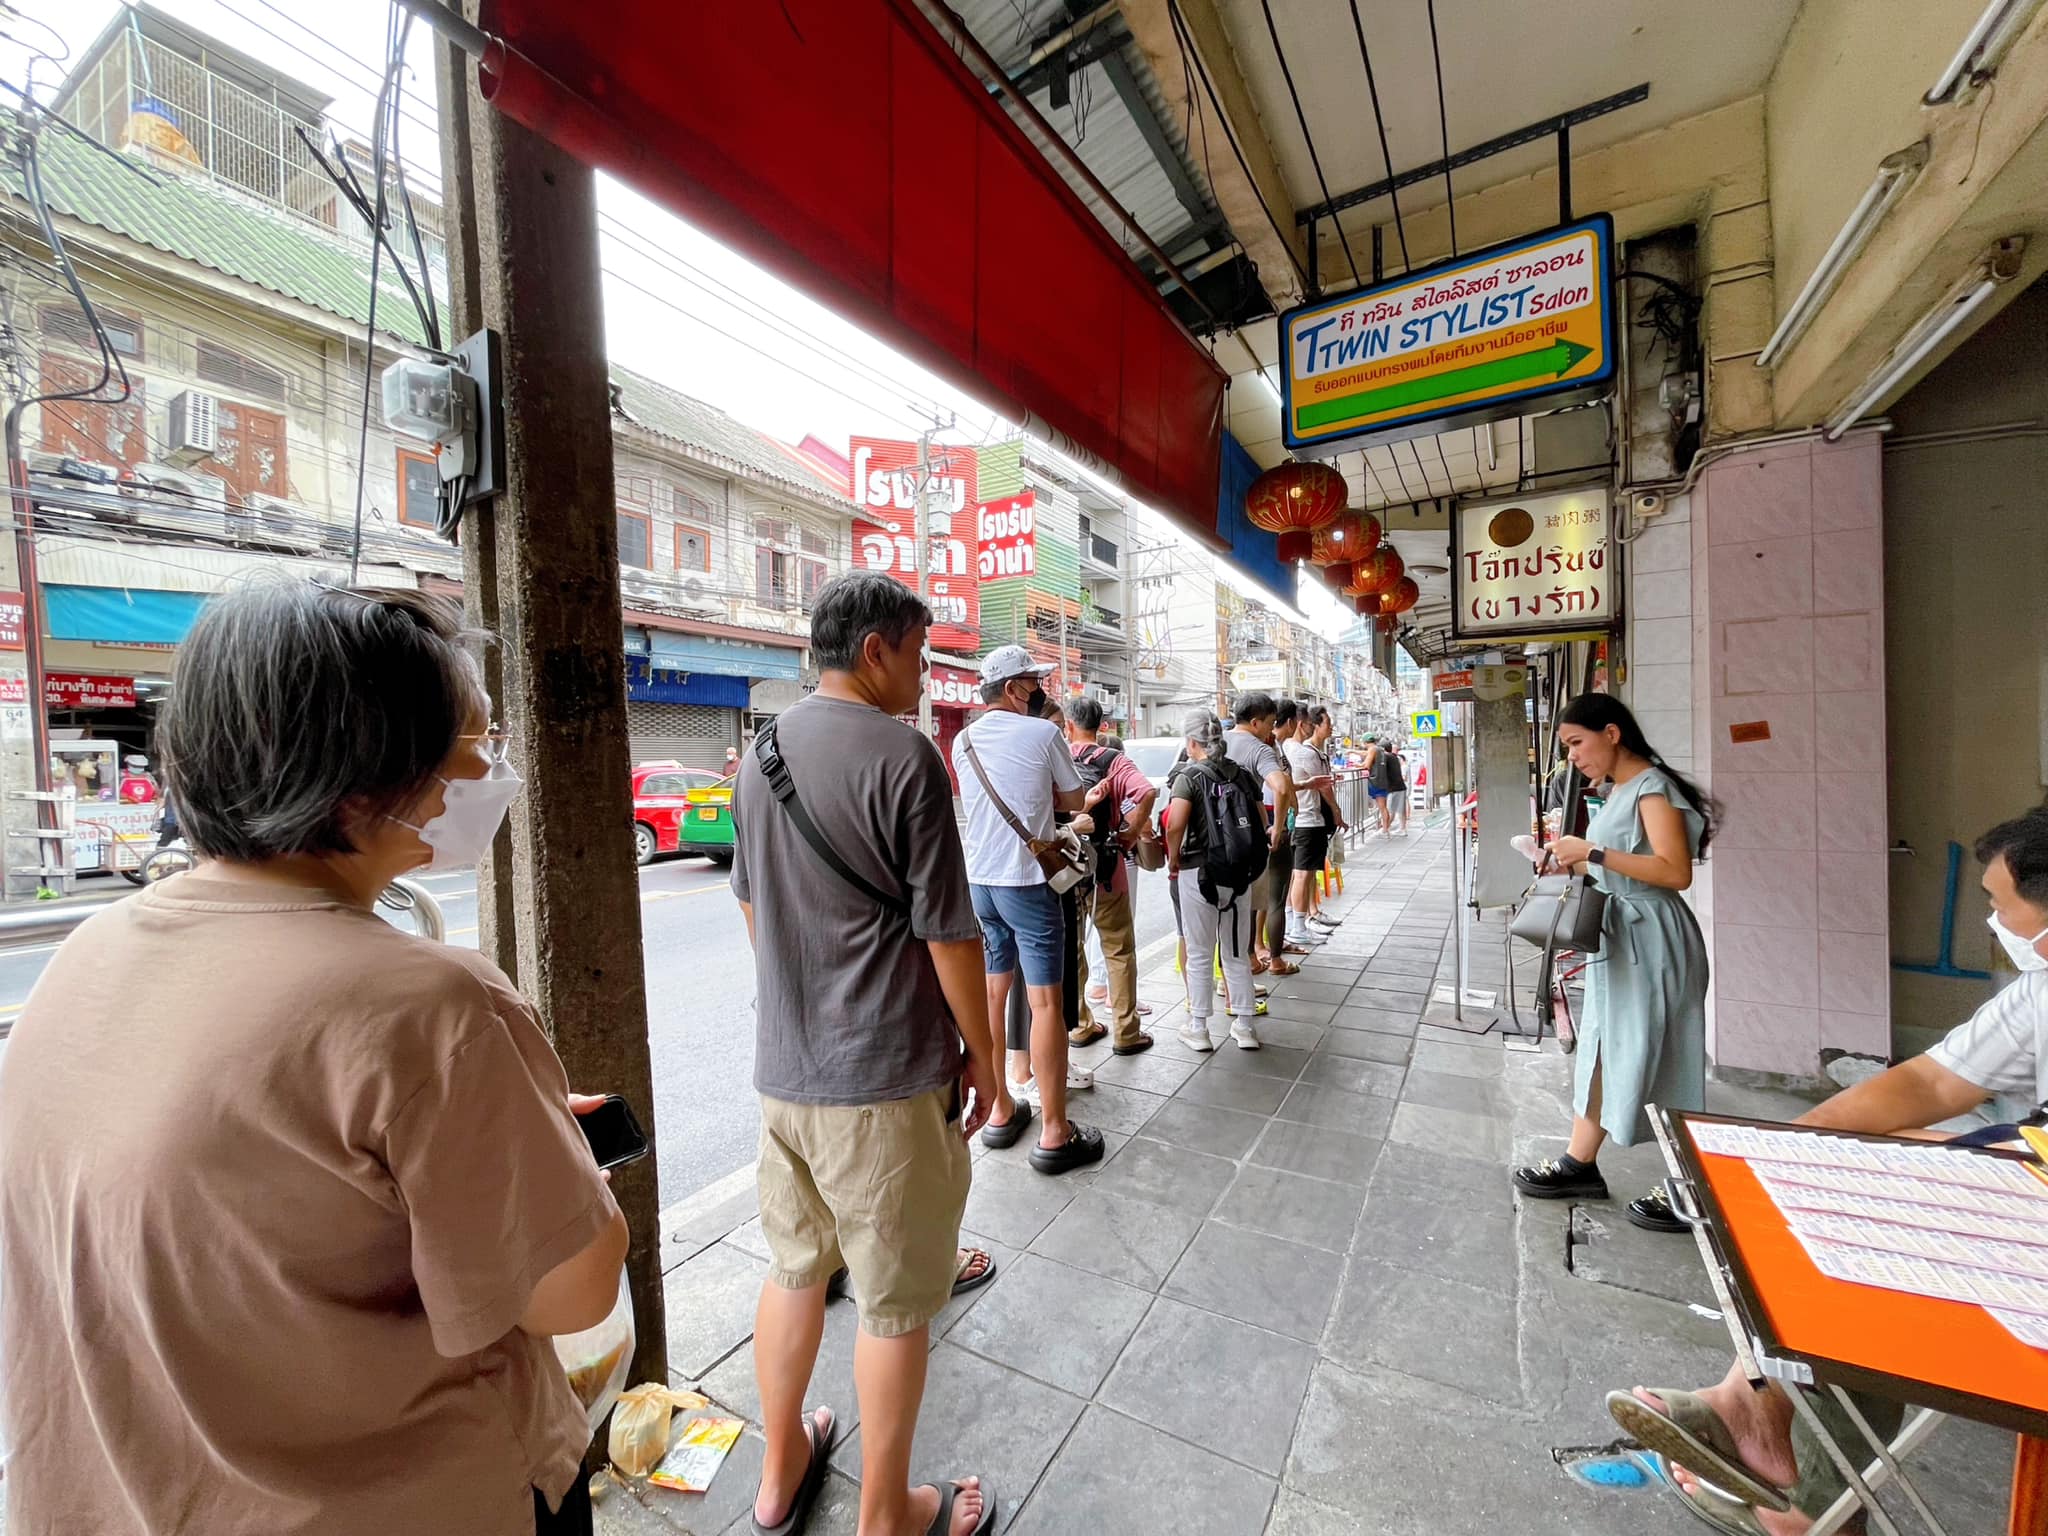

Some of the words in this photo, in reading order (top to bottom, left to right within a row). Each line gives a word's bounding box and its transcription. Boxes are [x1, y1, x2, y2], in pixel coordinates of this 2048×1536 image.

[1362, 302, 1402, 326] ทวิน
[1411, 268, 1501, 312] สไตลิสต์
[1506, 249, 1585, 285] ซาลอน
[1400, 285, 1536, 350] STYLIST
[1530, 286, 1589, 316] Salon
[978, 502, 1032, 542] โรงรับ
[978, 538, 1033, 577] จำนำ
[1471, 585, 1600, 620] (บางรัก)
